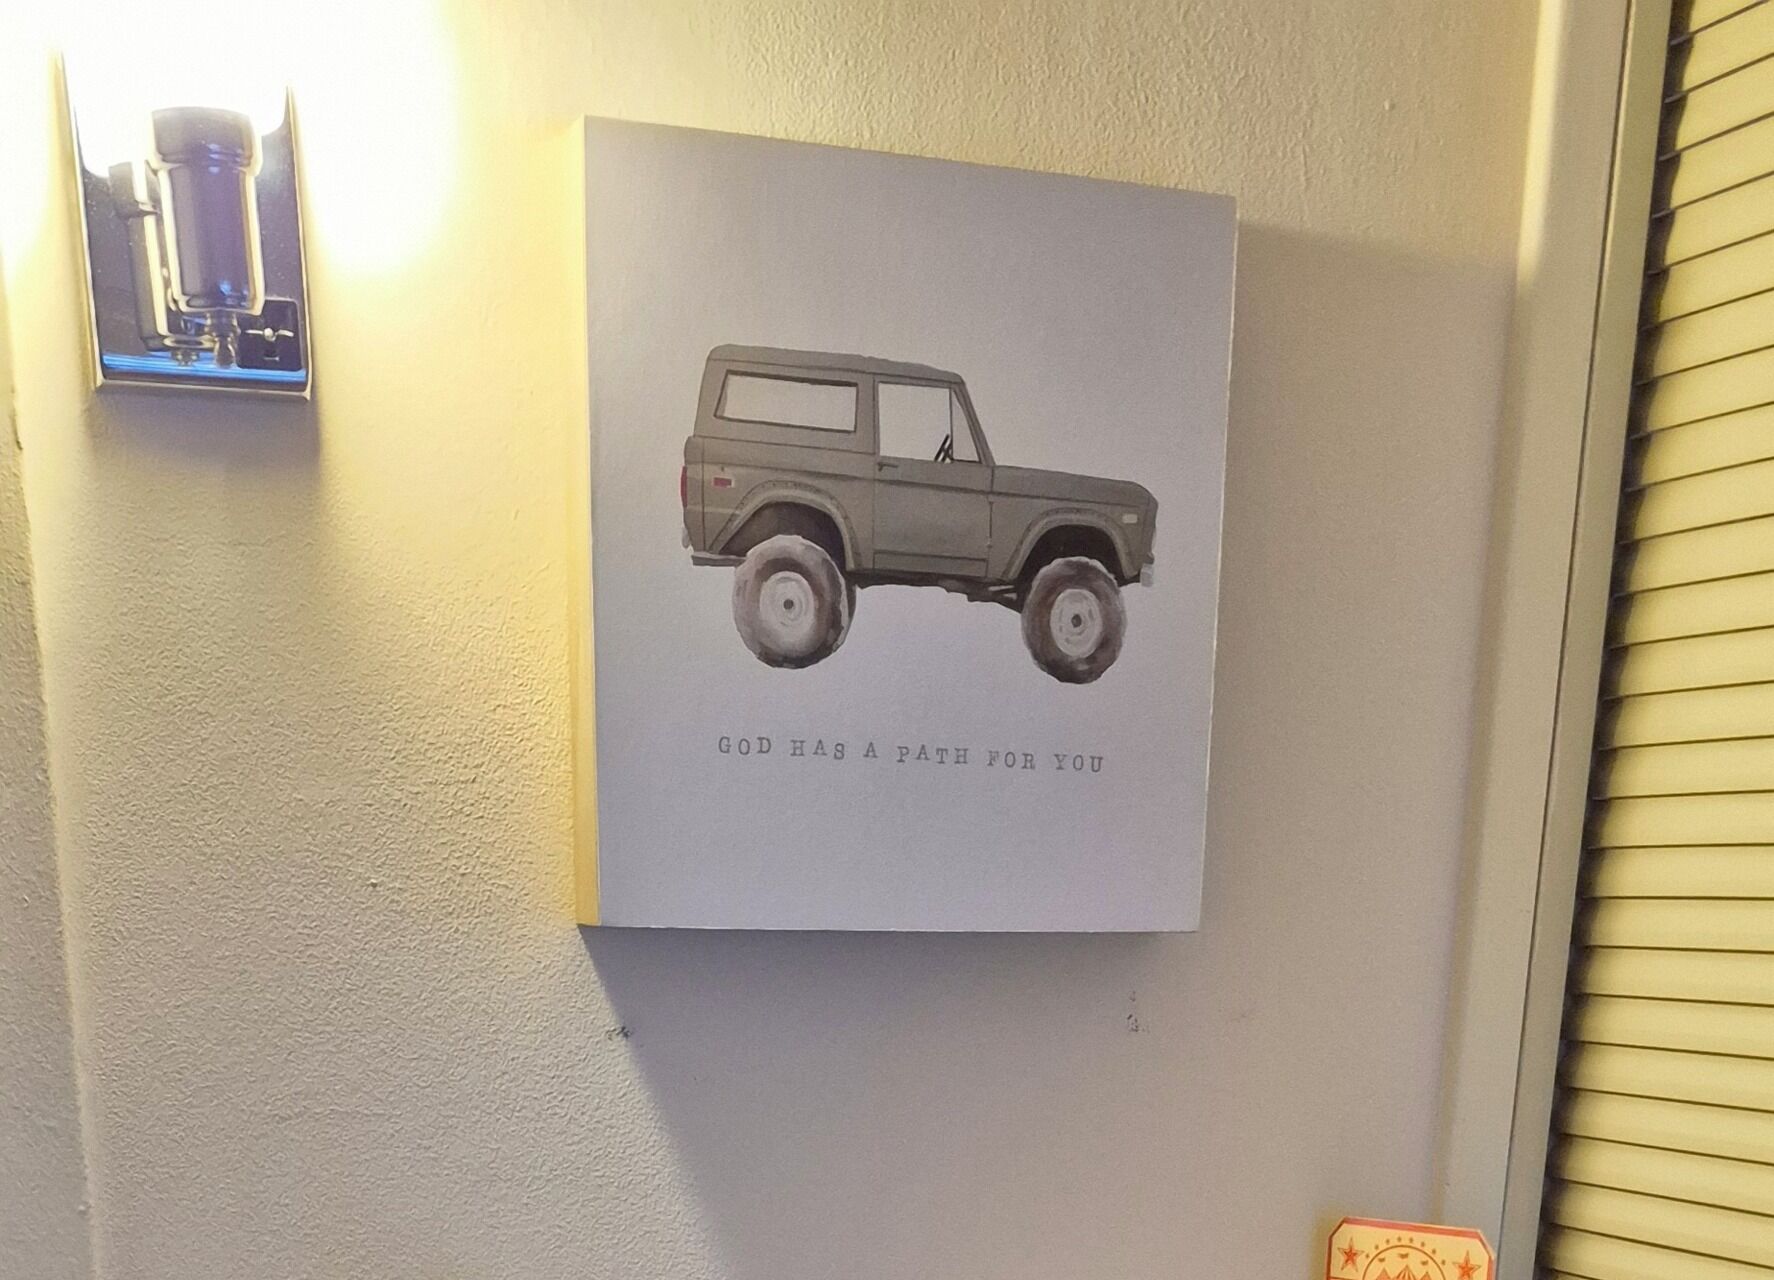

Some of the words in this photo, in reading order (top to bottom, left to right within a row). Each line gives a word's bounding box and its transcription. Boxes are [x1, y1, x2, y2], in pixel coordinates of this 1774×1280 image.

[718, 736, 772, 756] GOD
[790, 738, 845, 761] HAS
[862, 741, 879, 758] A
[896, 743, 969, 765] PATH
[987, 749, 1036, 771] FOR
[1054, 753, 1104, 774] YOU
